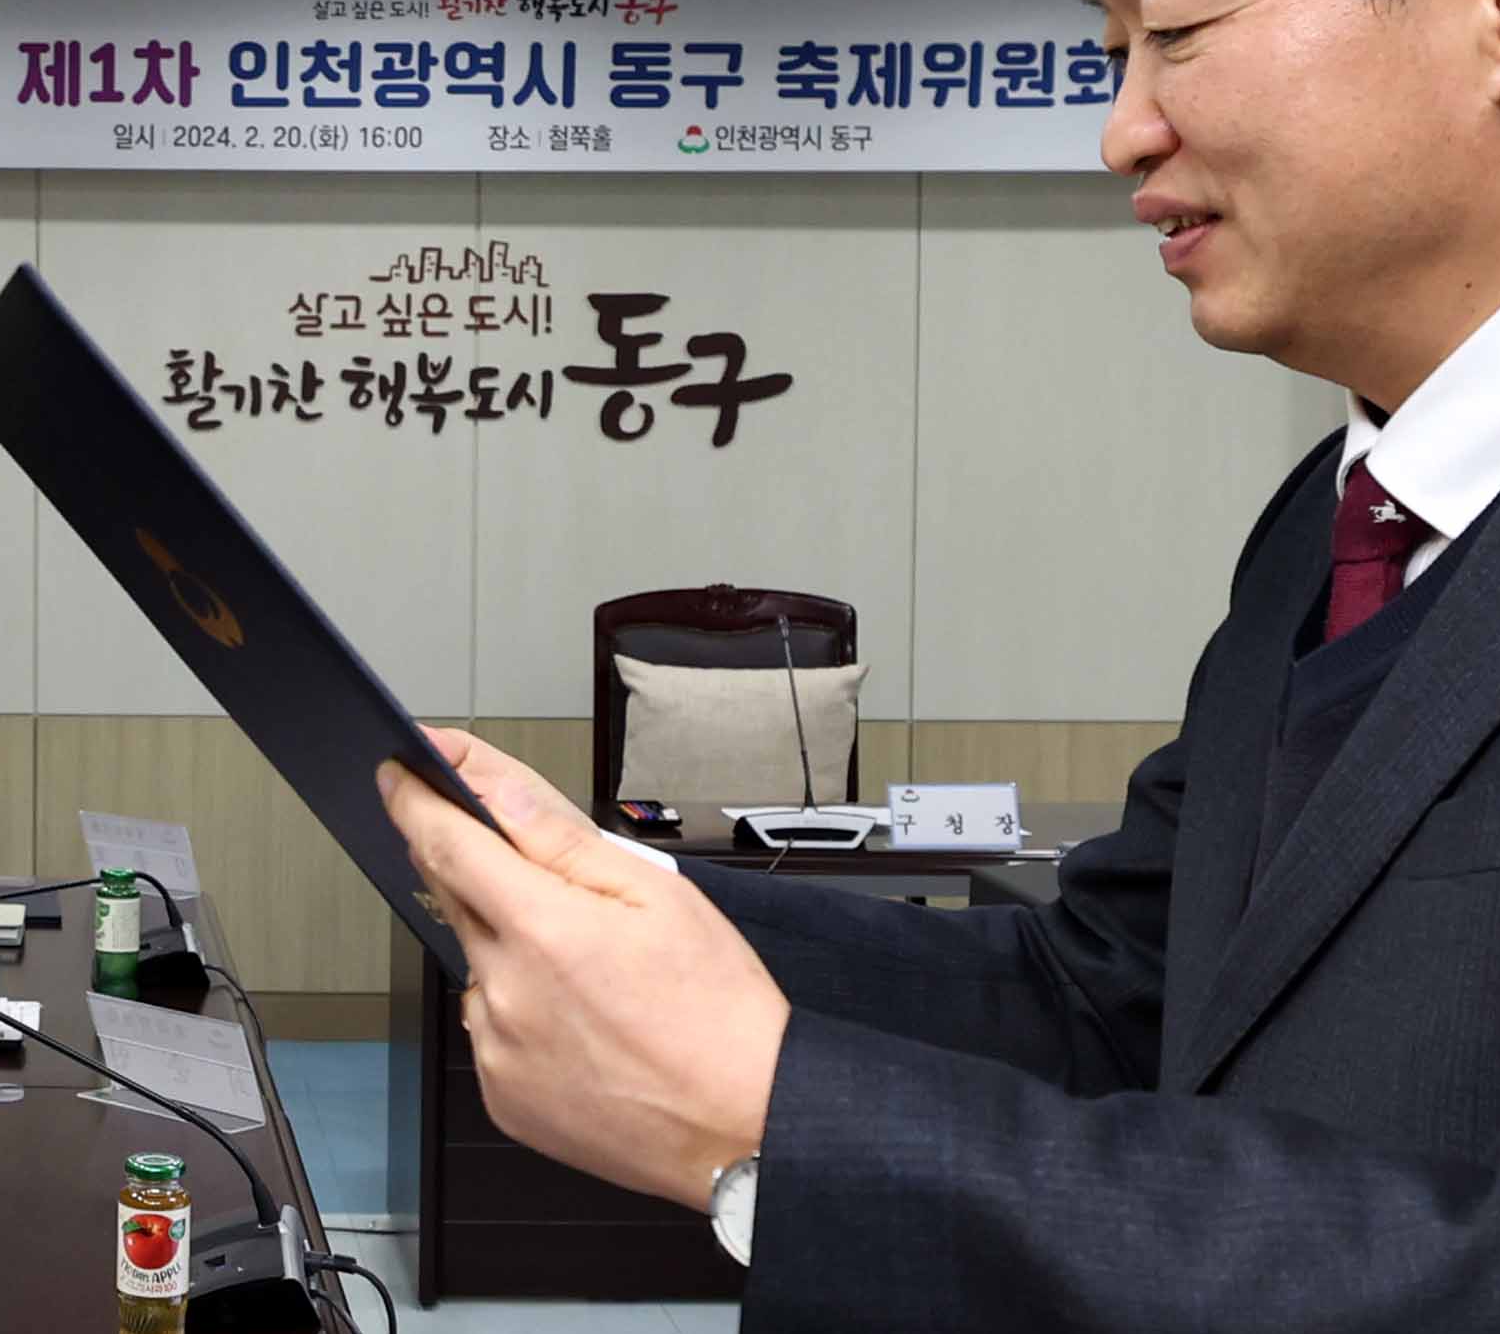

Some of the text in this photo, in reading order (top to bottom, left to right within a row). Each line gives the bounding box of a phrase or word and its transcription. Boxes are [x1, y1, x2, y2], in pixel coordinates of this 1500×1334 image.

[313, 0, 430, 21] 살고 싶은 도시!
[17, 38, 201, 108] 제1차
[228, 39, 577, 110] 인천광역시
[608, 40, 745, 110] 동구
[112, 123, 423, 151] 일시 2024. 2. 20.(화) 16:00
[488, 124, 613, 152] 장소 철쭉홀
[714, 124, 873, 152] 인천광역시 동구
[287, 292, 553, 338] 살고 싶은 도시!
[161, 291, 794, 449] 활기찬 행복도시 동구
